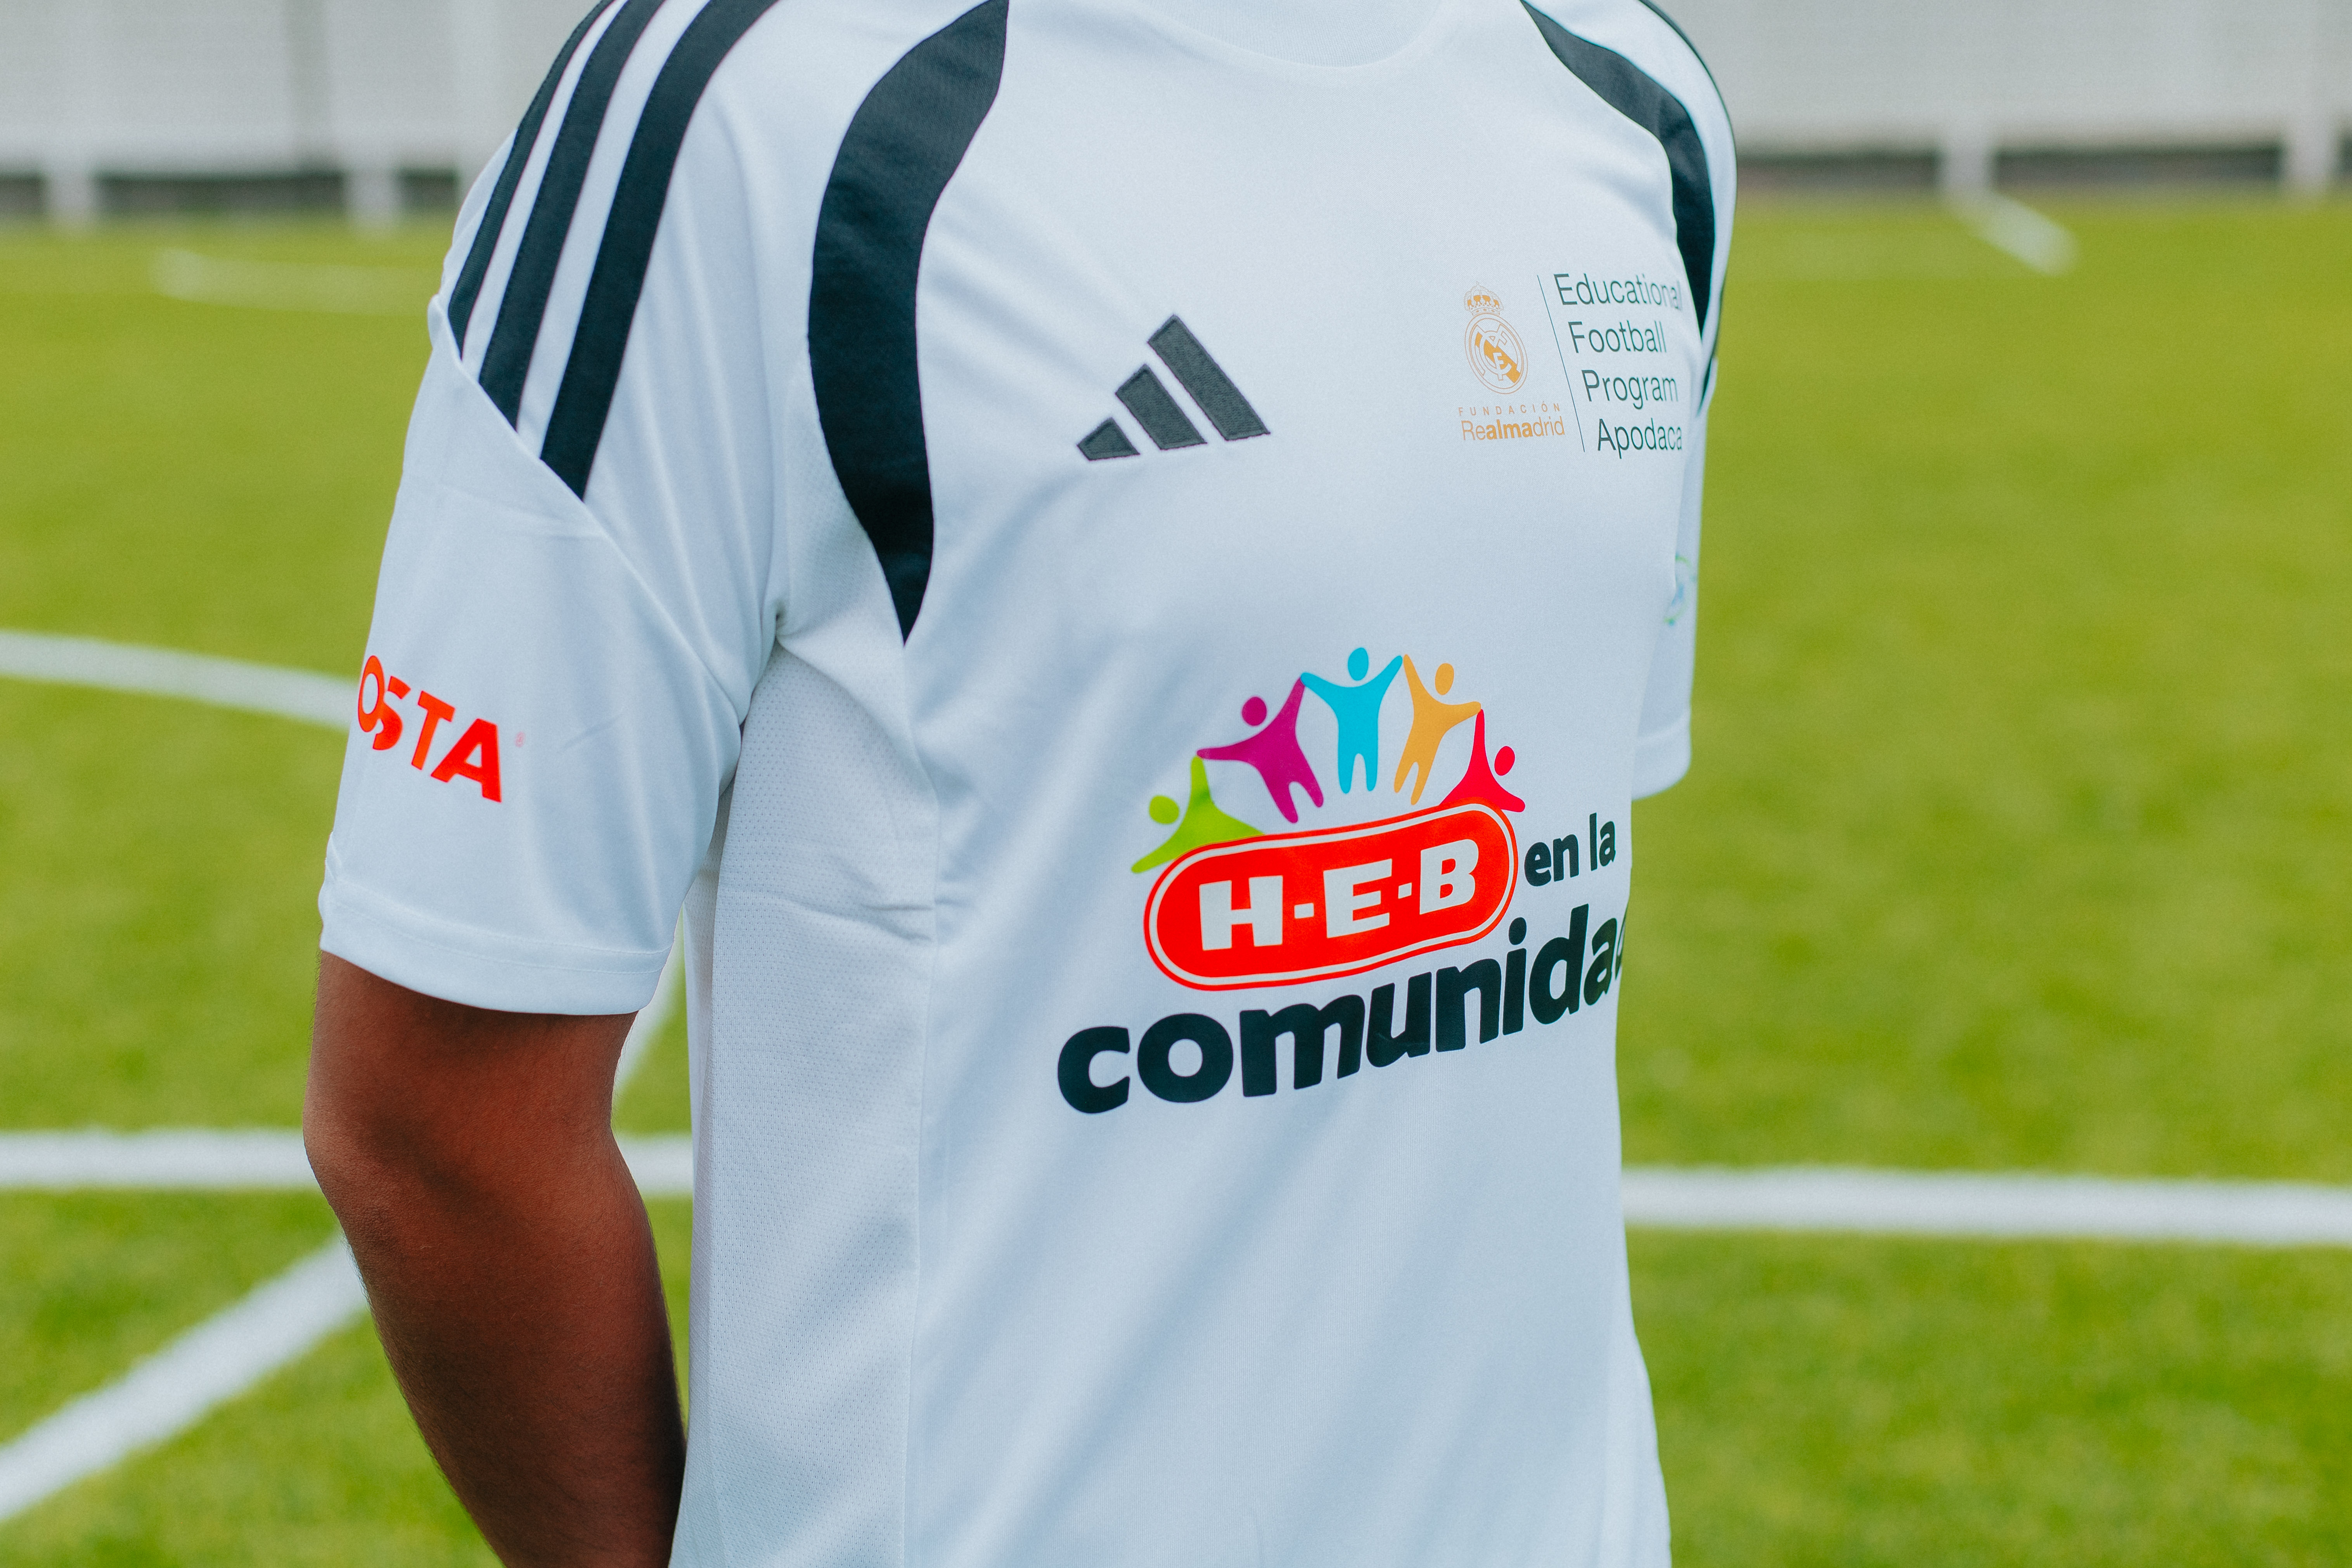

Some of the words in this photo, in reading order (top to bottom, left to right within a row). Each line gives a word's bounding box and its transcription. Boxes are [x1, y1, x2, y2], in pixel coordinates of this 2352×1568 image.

[1554, 273, 1682, 310] Educational
[1568, 320, 1667, 353] Football
[1582, 370, 1679, 409] Program
[1459, 401, 1560, 416] FUNDACIÓN
[1461, 417, 1565, 440] Realmadrid
[1597, 418, 1682, 459] Apodaca
[1524, 834, 1579, 887] en
[1589, 812, 1616, 871] la
